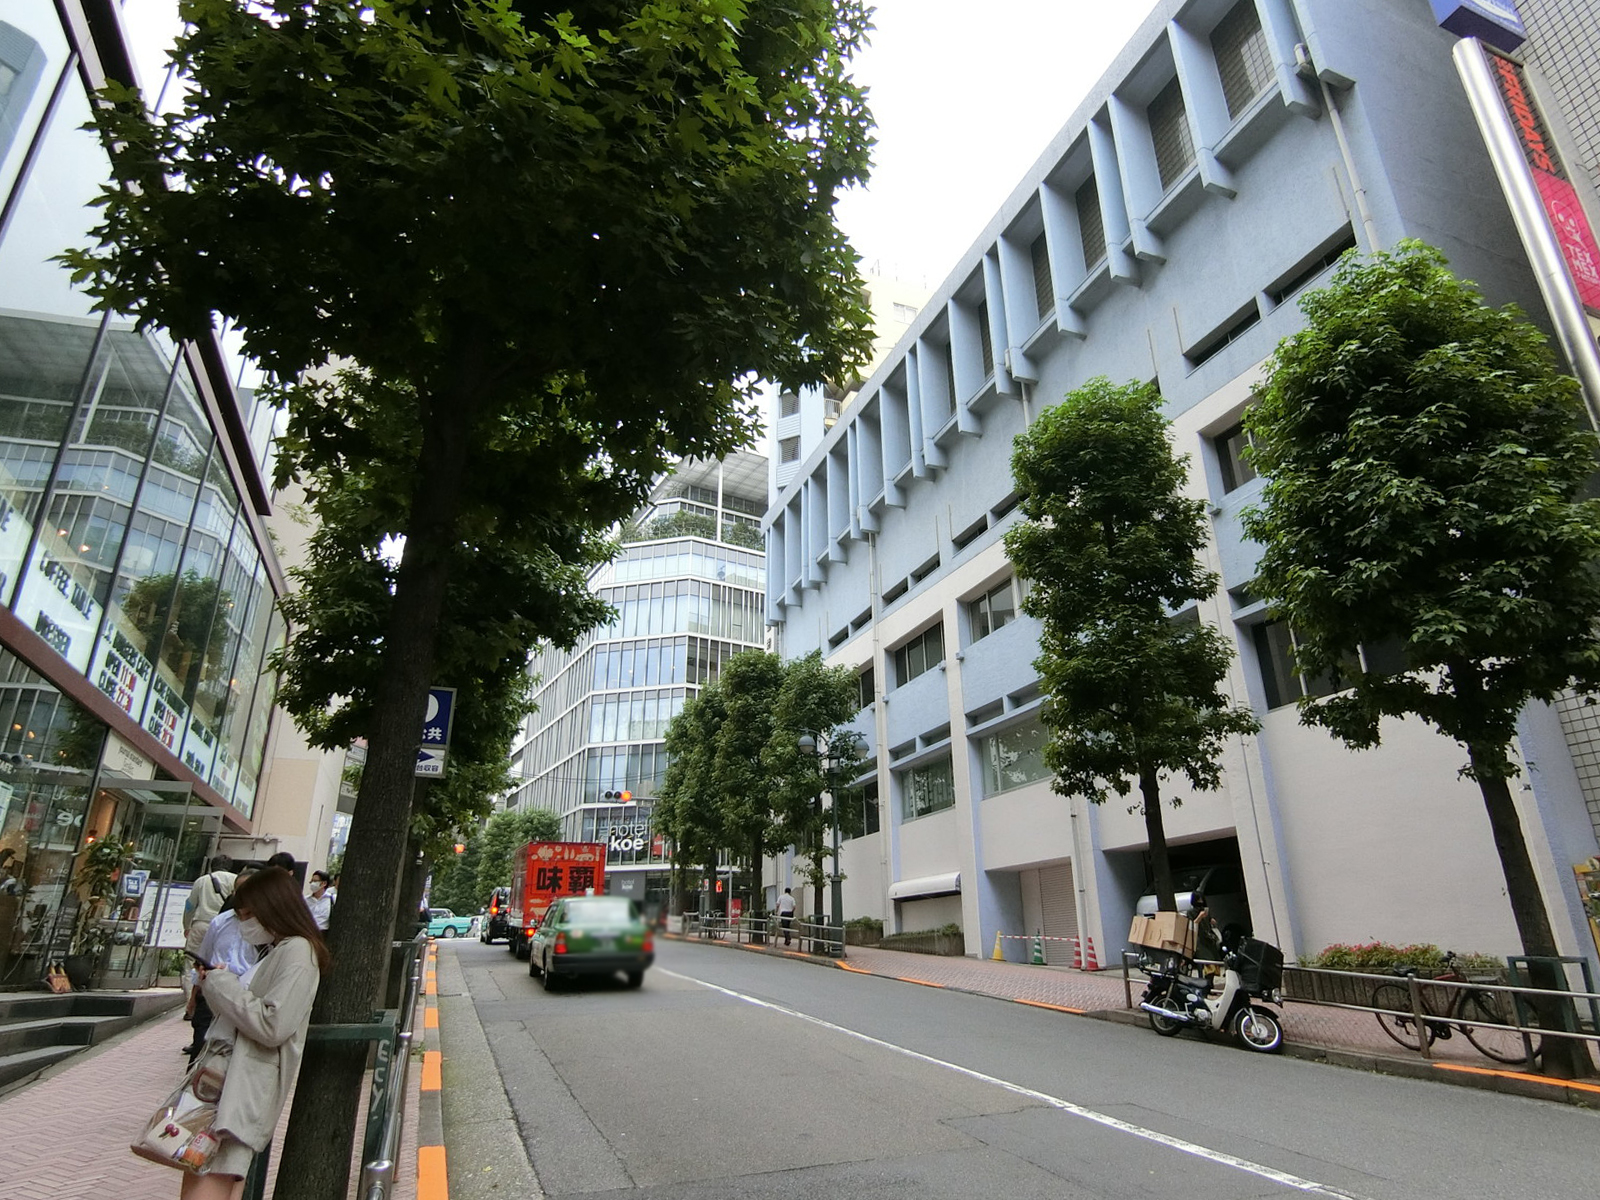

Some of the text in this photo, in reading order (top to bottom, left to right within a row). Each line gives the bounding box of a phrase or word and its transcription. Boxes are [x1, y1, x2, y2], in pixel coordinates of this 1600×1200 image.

[1566, 243, 1594, 265] TEX
[1572, 258, 1600, 279] MEX
[105, 650, 121, 678] OPEN
[610, 821, 648, 836] hotel
